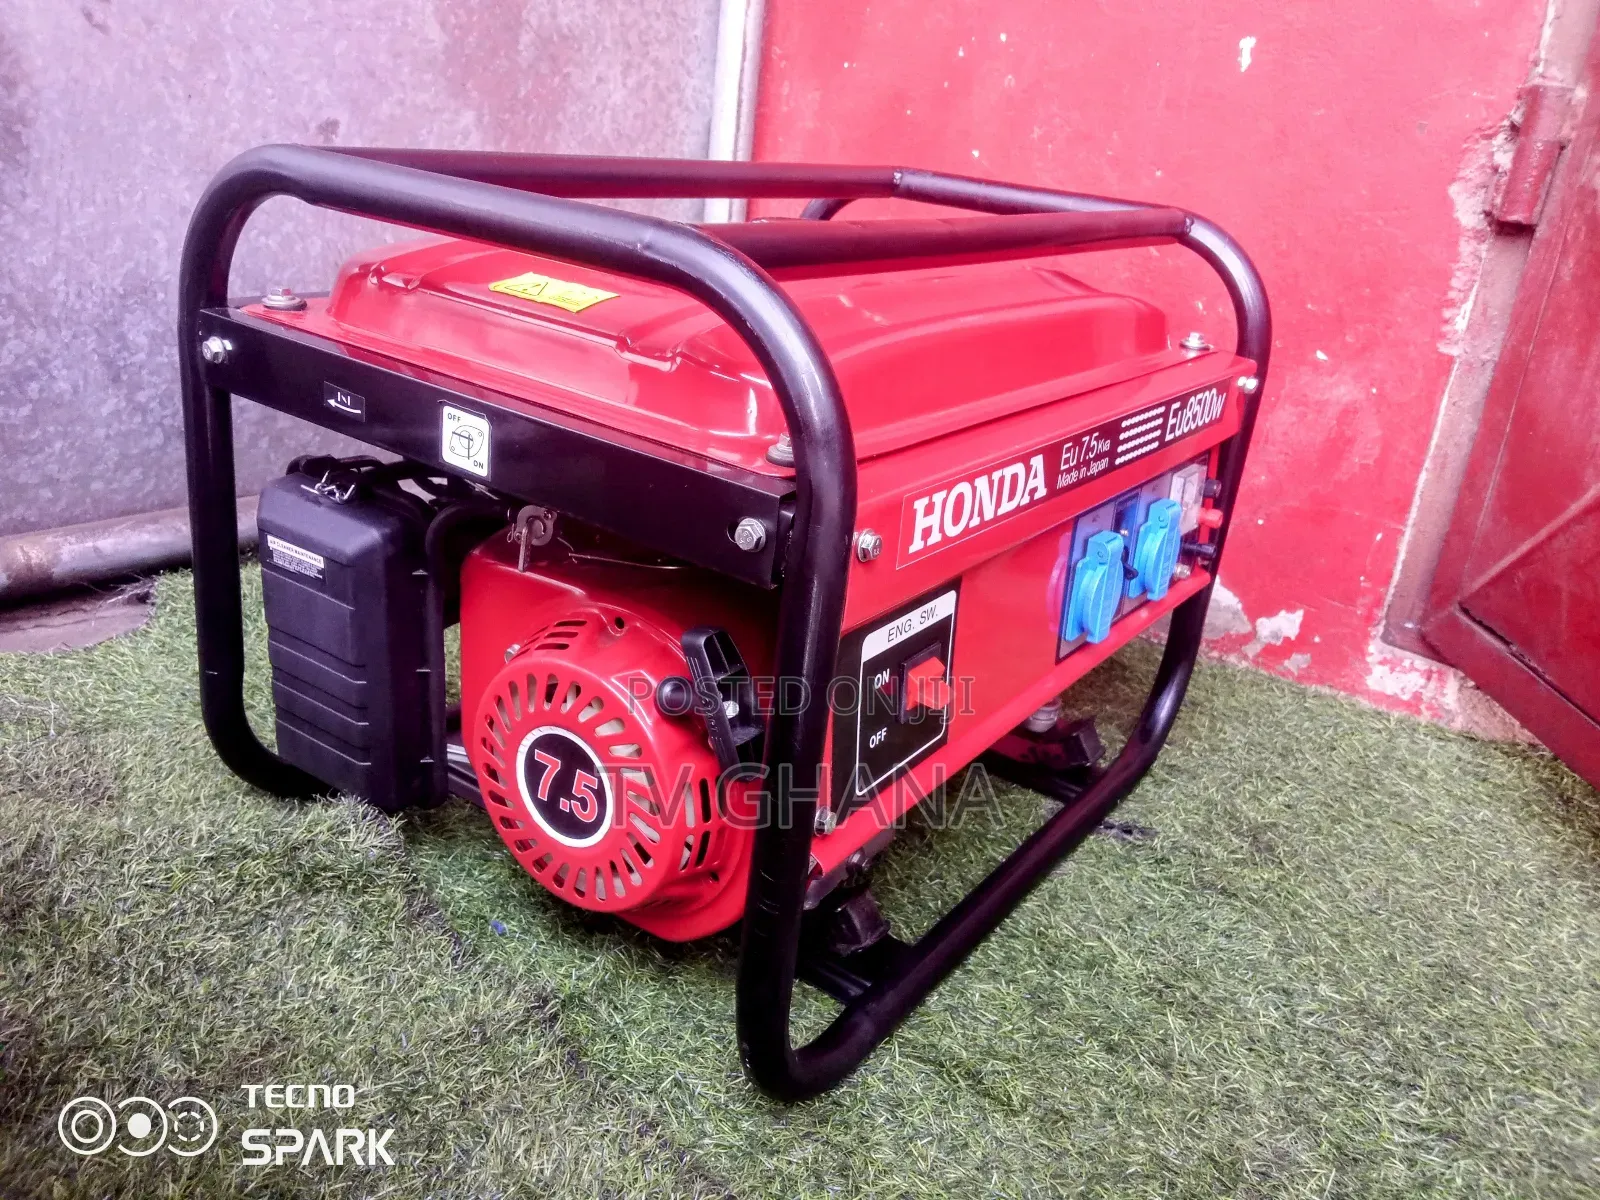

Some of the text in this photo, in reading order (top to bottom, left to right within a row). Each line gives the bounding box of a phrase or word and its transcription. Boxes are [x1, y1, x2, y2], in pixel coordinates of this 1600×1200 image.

[447, 412, 461, 423] OFF
[1164, 387, 1226, 442] Eu8500w
[473, 459, 484, 470] ON
[1060, 442, 1079, 470] Eu
[1056, 456, 1109, 490] Made in Japan
[908, 453, 1047, 555] HONDA
[887, 604, 938, 643] ENG. SW.
[874, 668, 890, 690] ON
[869, 727, 887, 749] OFF
[534, 748, 598, 823] 7.5
